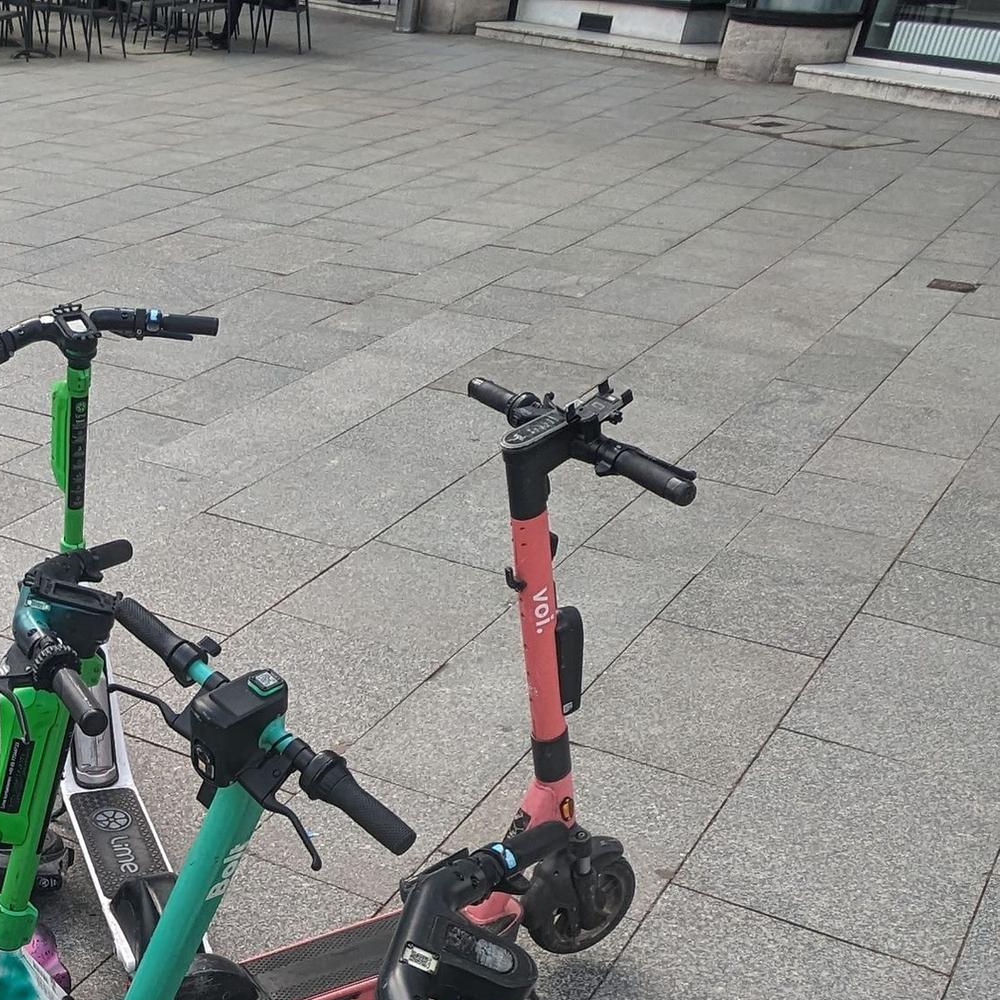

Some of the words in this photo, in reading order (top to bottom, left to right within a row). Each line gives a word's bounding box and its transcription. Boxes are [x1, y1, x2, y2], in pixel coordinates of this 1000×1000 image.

[533, 587, 554, 634] voi.
[110, 835, 139, 874] Lime
[205, 840, 251, 901] Bolt
